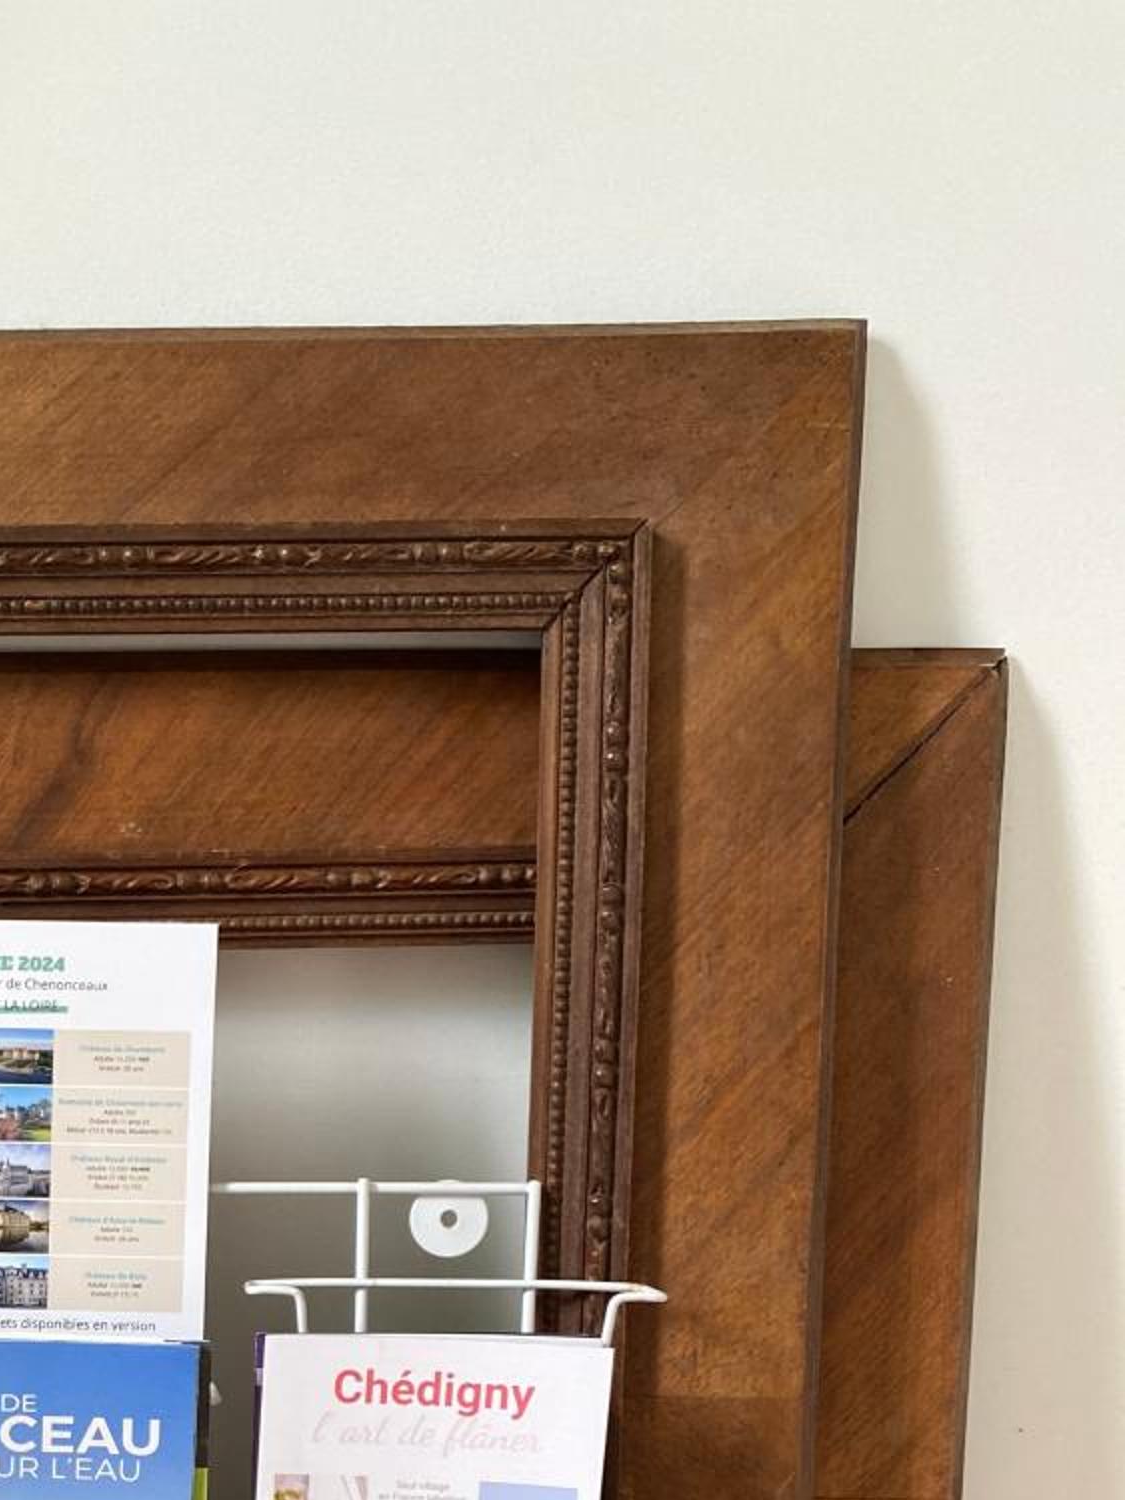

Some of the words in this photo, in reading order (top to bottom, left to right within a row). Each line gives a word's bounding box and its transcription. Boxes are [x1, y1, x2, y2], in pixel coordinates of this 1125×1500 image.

[18, 956, 65, 972] 2024
[6, 979, 21, 990] de
[25, 978, 108, 991] Chenonceaux
[5, 999, 18, 1011] LA
[21, 1317, 89, 1332] disponibles
[93, 1320, 108, 1329] en
[112, 1320, 155, 1331] version
[334, 1368, 535, 1420] Chédigny
[0, 1393, 36, 1412] DE
[51, 1457, 140, 1482] L'EAU
